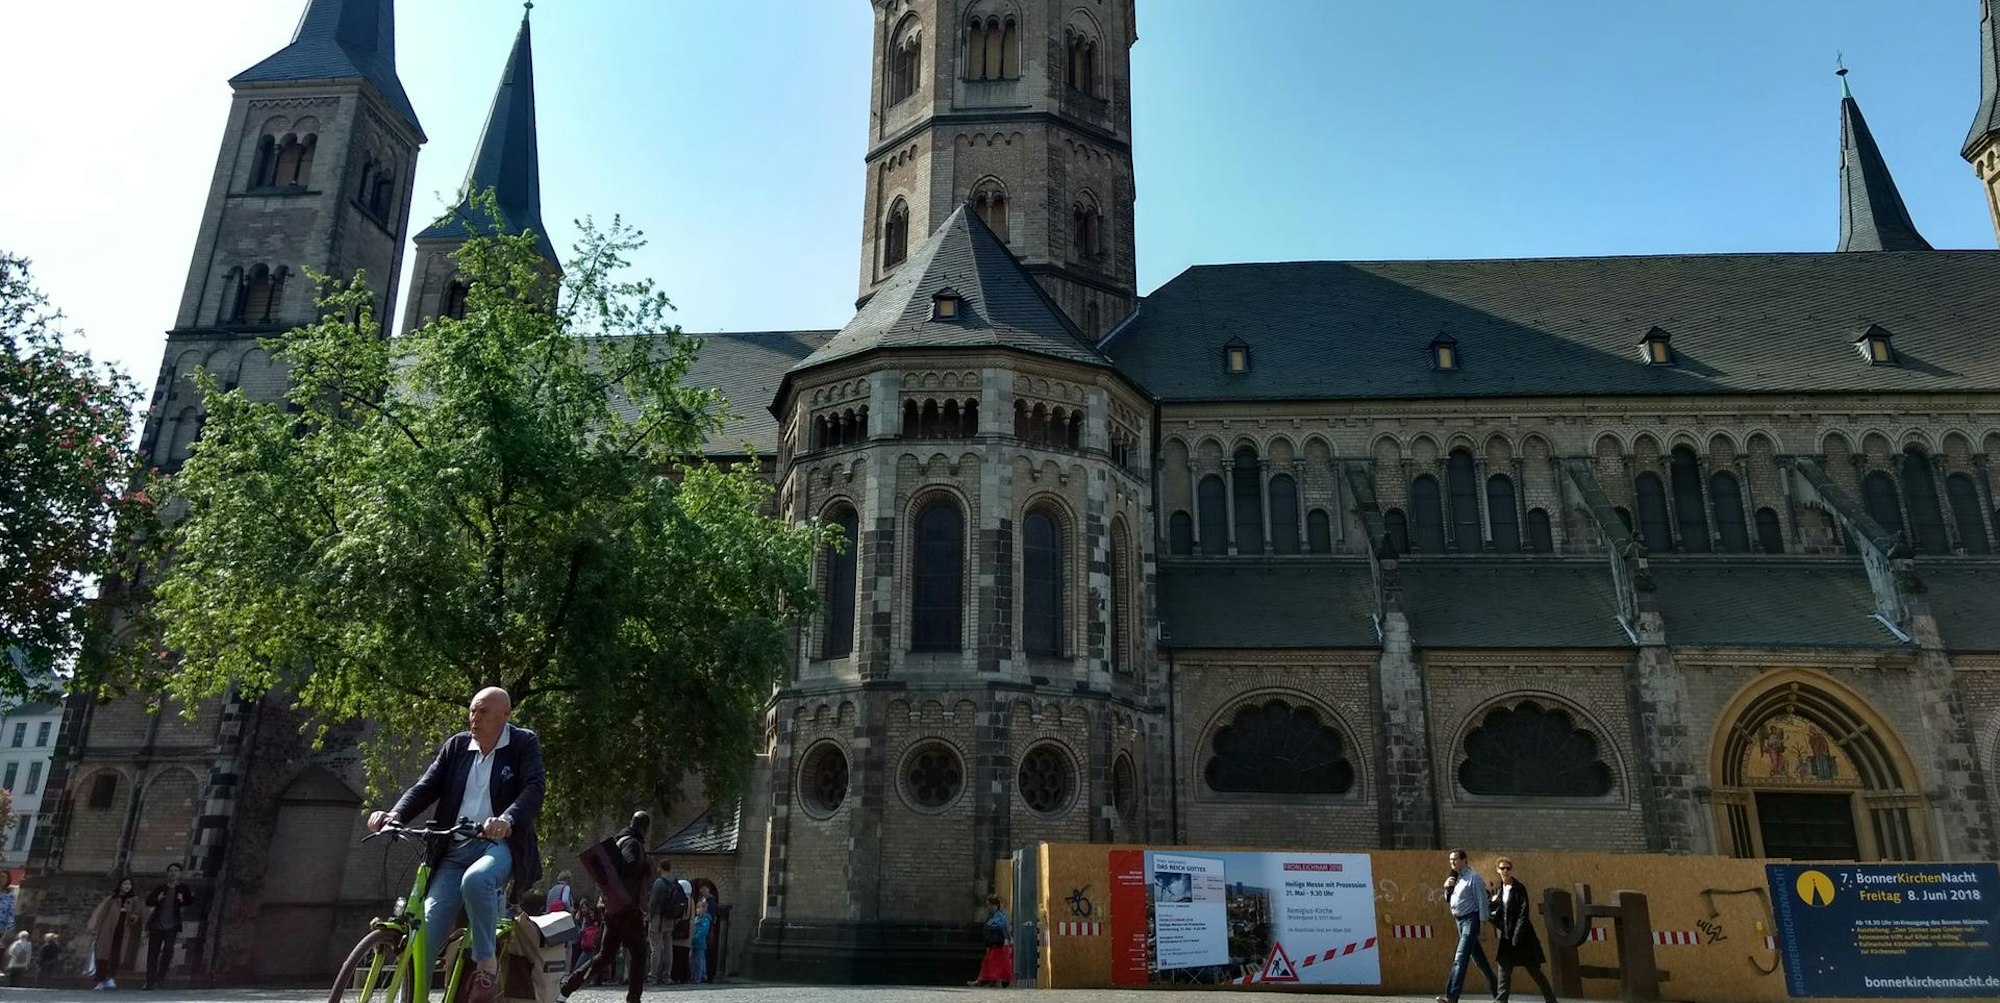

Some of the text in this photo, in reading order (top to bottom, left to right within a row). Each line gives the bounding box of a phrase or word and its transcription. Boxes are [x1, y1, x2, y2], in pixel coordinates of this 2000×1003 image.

[1186, 865, 1206, 873] GOTTES
[1284, 863, 1328, 871] FRONLEICHNAM
[1840, 872, 1977, 884] 7. BonnerKirchenNacht
[1285, 880, 1305, 889] Heilige
[1336, 881, 1367, 889] Prozession
[1859, 889, 1982, 904] Freitag 8. Juni 2018
[1864, 976, 2000, 988] bonnerkirchennacht.de
